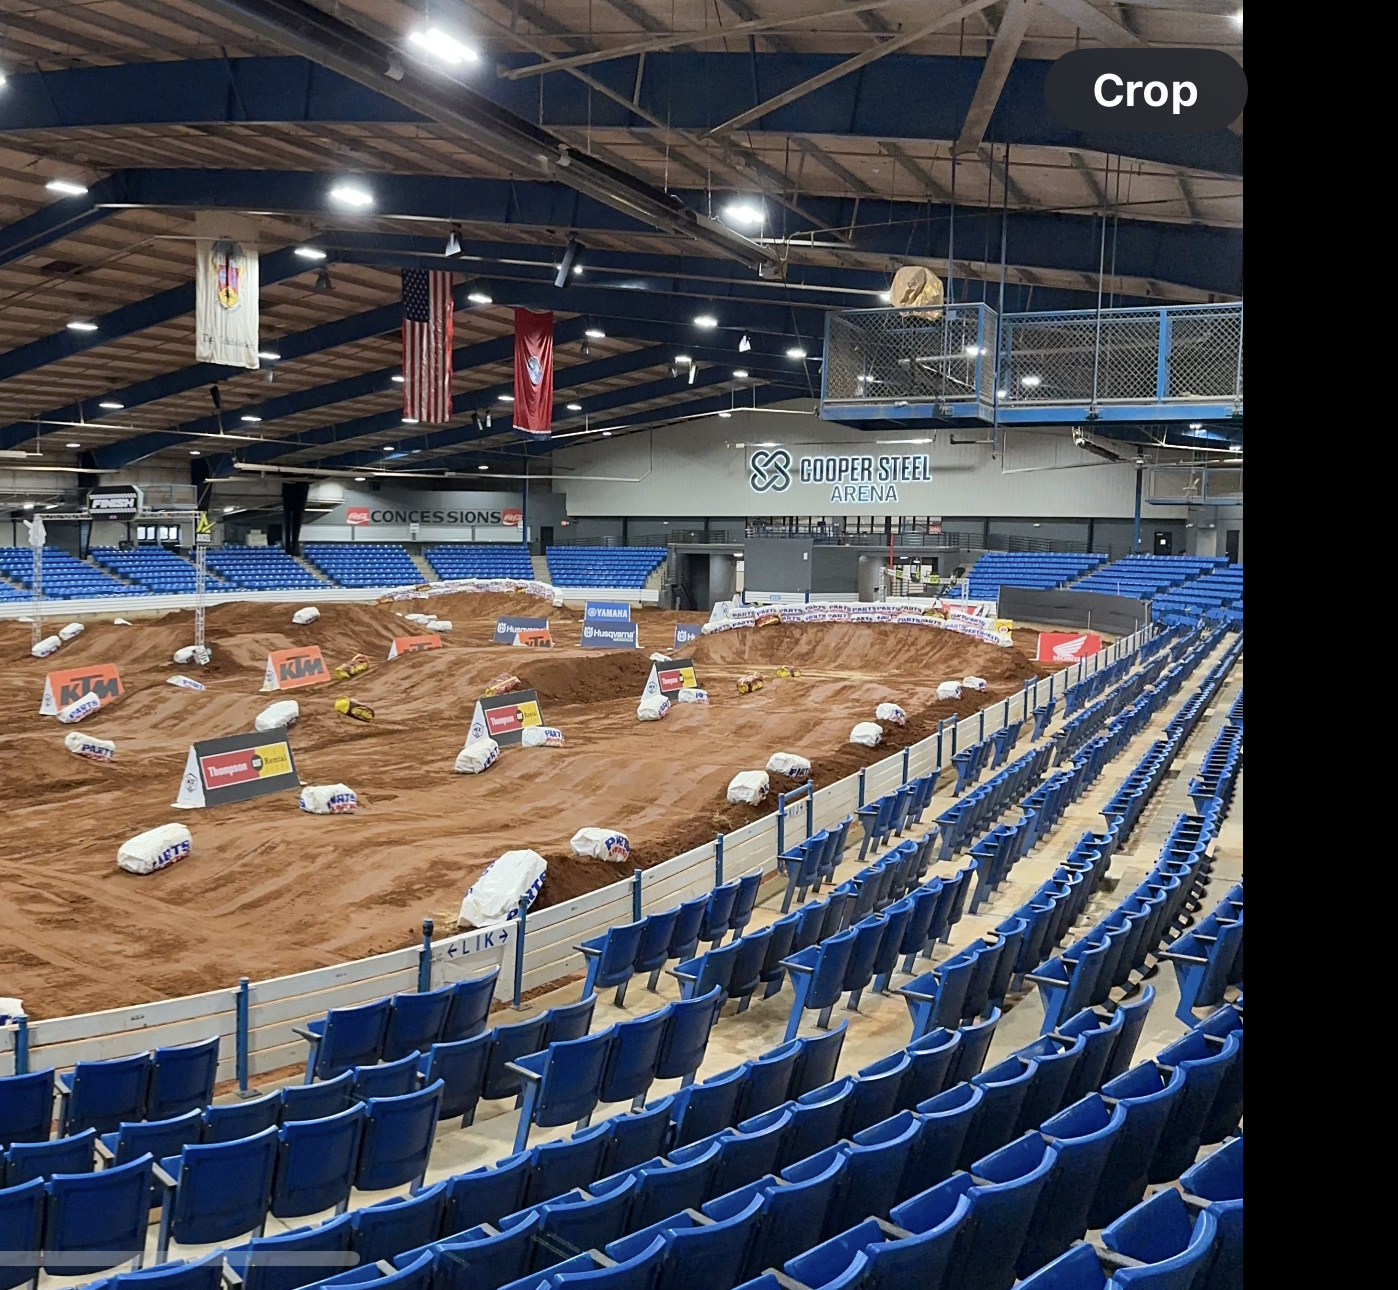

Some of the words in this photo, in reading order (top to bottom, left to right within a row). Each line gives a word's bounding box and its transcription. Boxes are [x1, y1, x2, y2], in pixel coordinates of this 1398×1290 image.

[801, 457, 872, 482] COOPER
[878, 455, 931, 481] STEEL
[831, 485, 898, 502] ARENA
[92, 498, 135, 509] FINISH
[371, 510, 501, 524] CONCESSIONS
[597, 608, 628, 618] YAMAHA
[280, 655, 325, 681] KTM
[60, 674, 119, 706] KTM
[207, 762, 248, 777] Thompson
